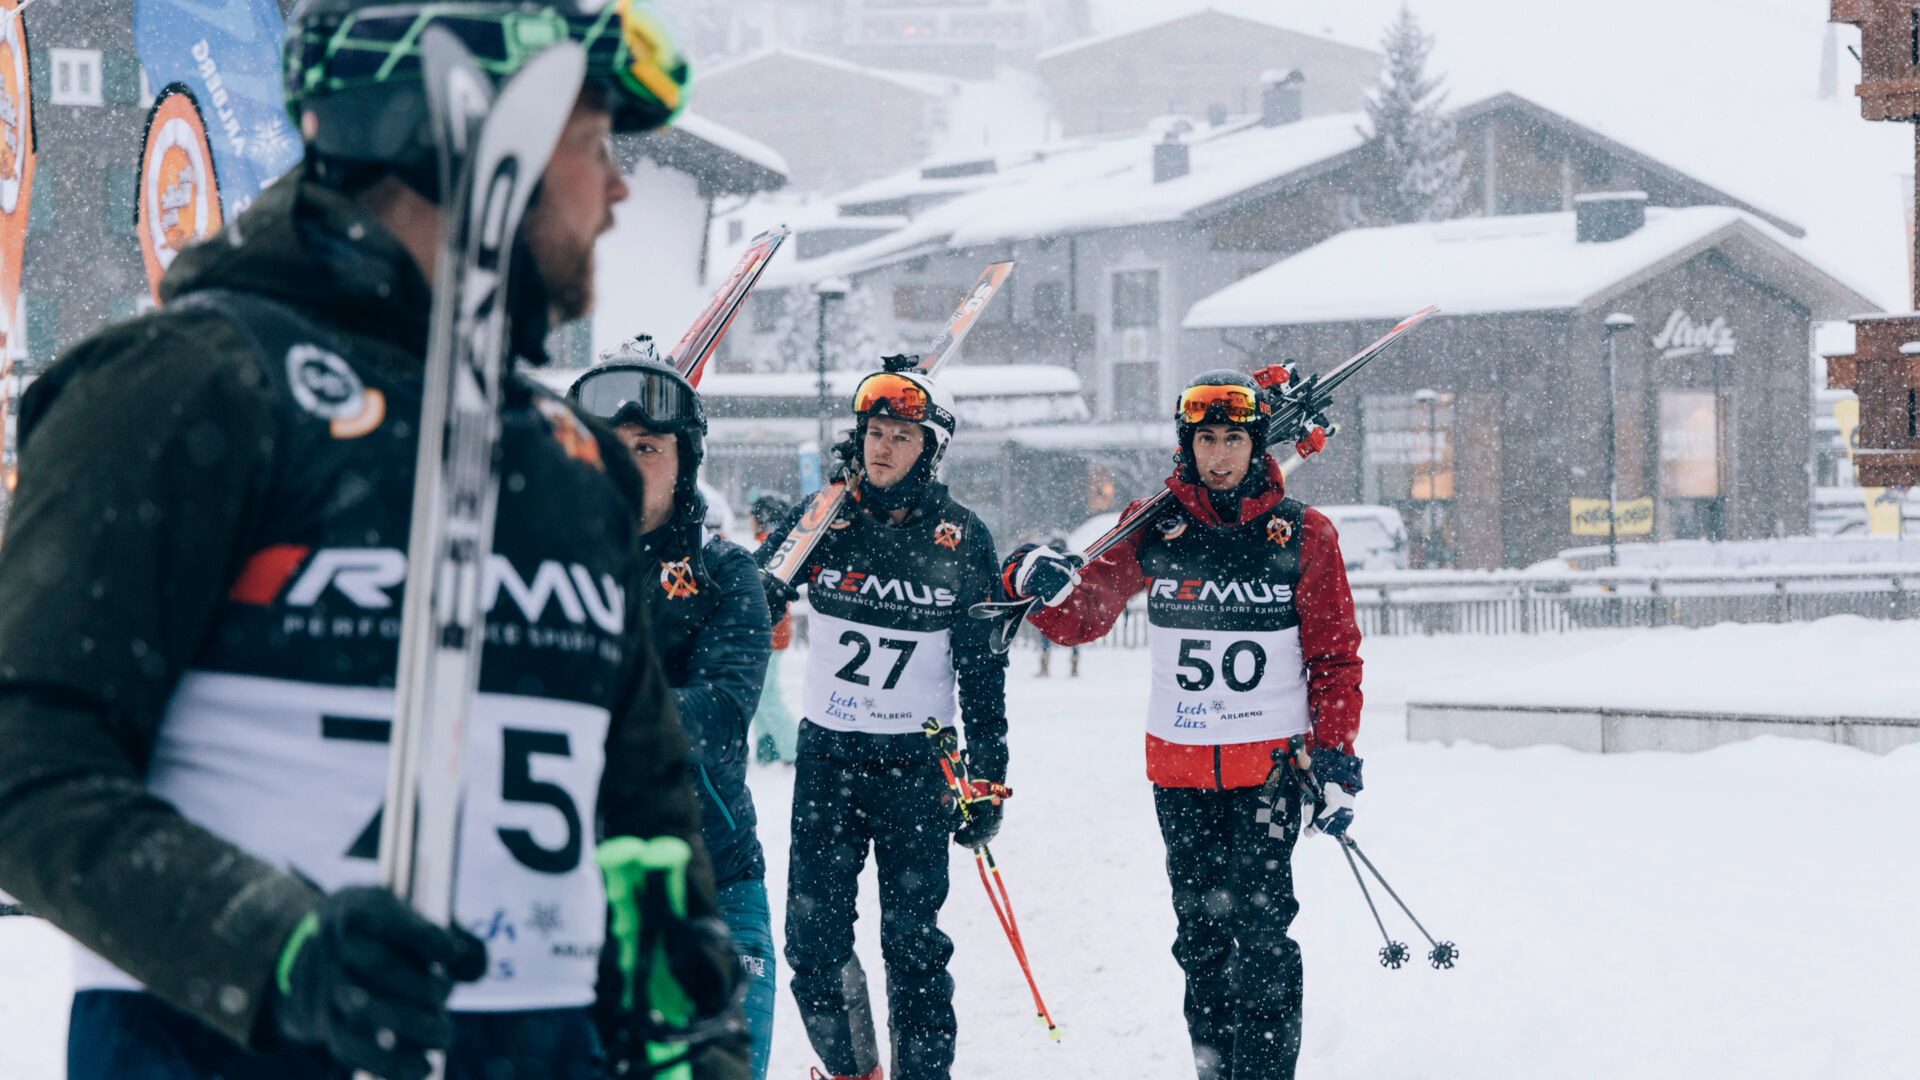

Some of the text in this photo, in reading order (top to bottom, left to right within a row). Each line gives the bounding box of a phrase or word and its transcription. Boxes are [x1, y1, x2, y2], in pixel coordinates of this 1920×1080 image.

[817, 568, 957, 608] REMUS
[1150, 578, 1293, 604] REMUS
[878, 601, 909, 612] SPORT
[1219, 604, 1251, 613] SPORT
[834, 630, 919, 690] 27
[1175, 638, 1267, 693] 50
[829, 691, 858, 709] Lech
[1176, 700, 1207, 716] Lech
[825, 703, 857, 722] Zürs
[869, 711, 913, 720] ARLBERG
[1220, 710, 1264, 721] ARLBERG
[1173, 715, 1208, 729] Zürs
